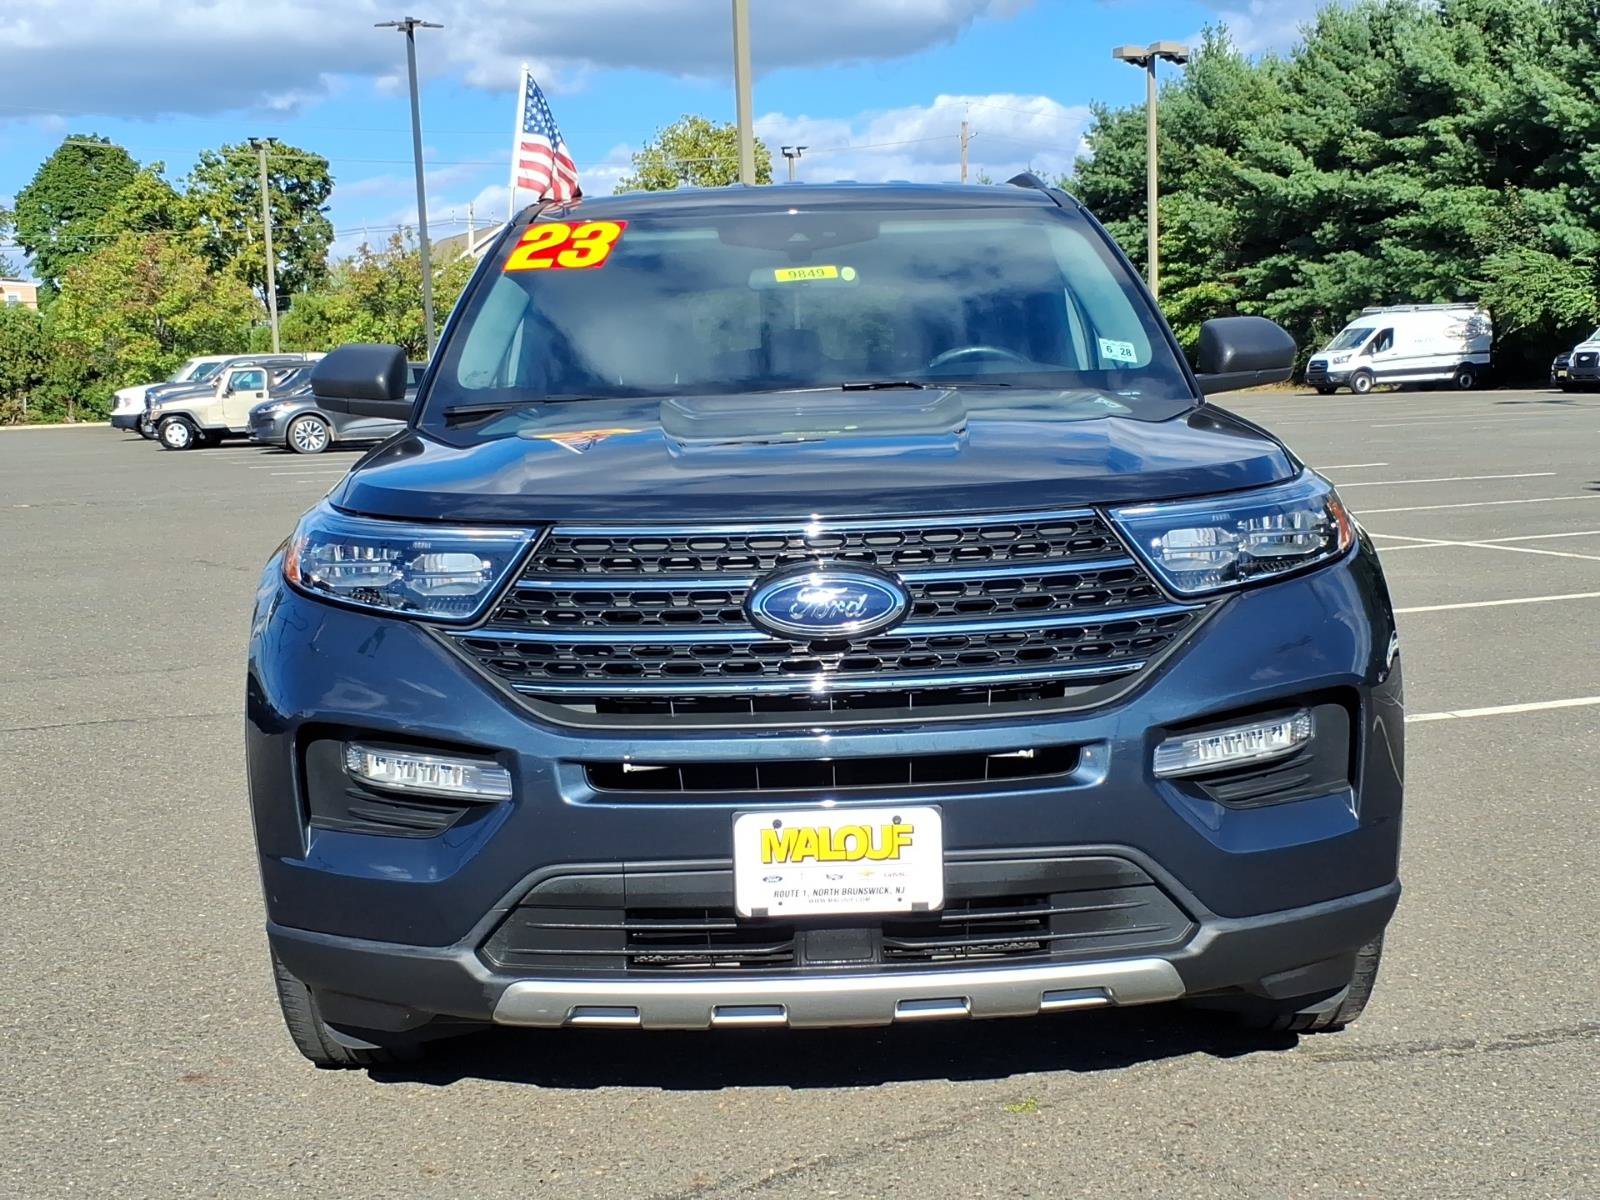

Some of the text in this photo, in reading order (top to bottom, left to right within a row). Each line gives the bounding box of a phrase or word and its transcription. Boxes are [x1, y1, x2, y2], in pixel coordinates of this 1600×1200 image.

[504, 221, 621, 271] 23
[788, 268, 825, 280] 9849
[1106, 345, 1132, 357] 6 28
[789, 586, 869, 620] Ford
[760, 824, 914, 864] MALOUF
[773, 889, 799, 899] ROUTE
[813, 887, 839, 897] NORTH
[841, 886, 893, 896] BRUNSWICK,
[895, 886, 906, 895] NJ
